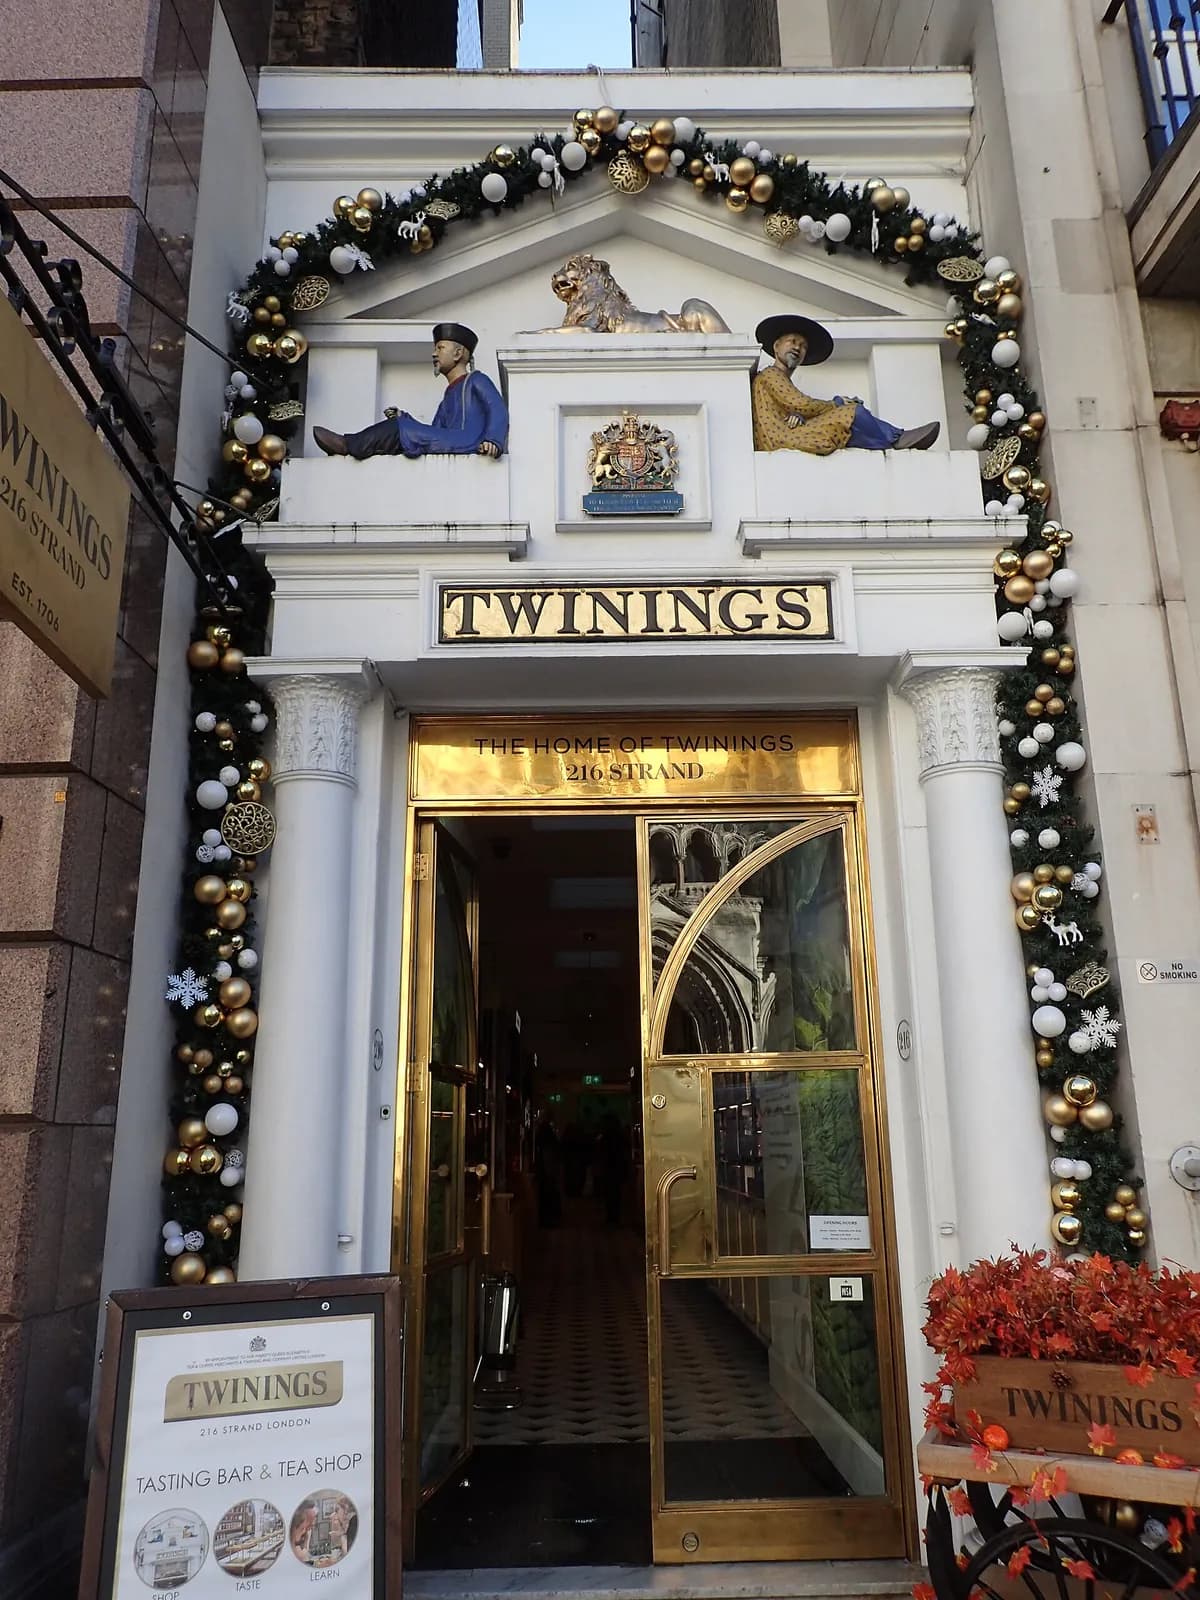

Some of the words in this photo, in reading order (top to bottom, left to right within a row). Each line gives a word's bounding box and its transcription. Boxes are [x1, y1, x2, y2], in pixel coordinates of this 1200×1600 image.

[0, 476, 26, 522] 216
[29, 510, 87, 591] STRAND
[11, 571, 34, 608] EST.
[38, 601, 60, 633] 1706
[446, 588, 812, 634] TWININGS
[474, 738, 525, 755] THE
[534, 737, 611, 755] HOME
[619, 736, 655, 753] OF
[660, 734, 794, 752] TWININGS
[566, 763, 604, 781] 216
[609, 762, 705, 781] STRAND
[1159, 971, 1198, 980] SMOKING
[1171, 962, 1184, 971] NO
[183, 1370, 328, 1411] TWININGS
[1001, 1387, 1183, 1432] TWININGS
[200, 1428, 218, 1437] 216
[223, 1422, 262, 1434] STRAND
[267, 1418, 311, 1430] LONDON
[136, 1469, 211, 1494] TASTING
[217, 1464, 254, 1485] BAR
[260, 1464, 272, 1480] &
[278, 1459, 309, 1477] TEA
[315, 1453, 362, 1474] SHOP
[309, 1569, 340, 1582] LEARN
[151, 1592, 180, 1600] SHOP
[235, 1580, 261, 1592] TASTE
